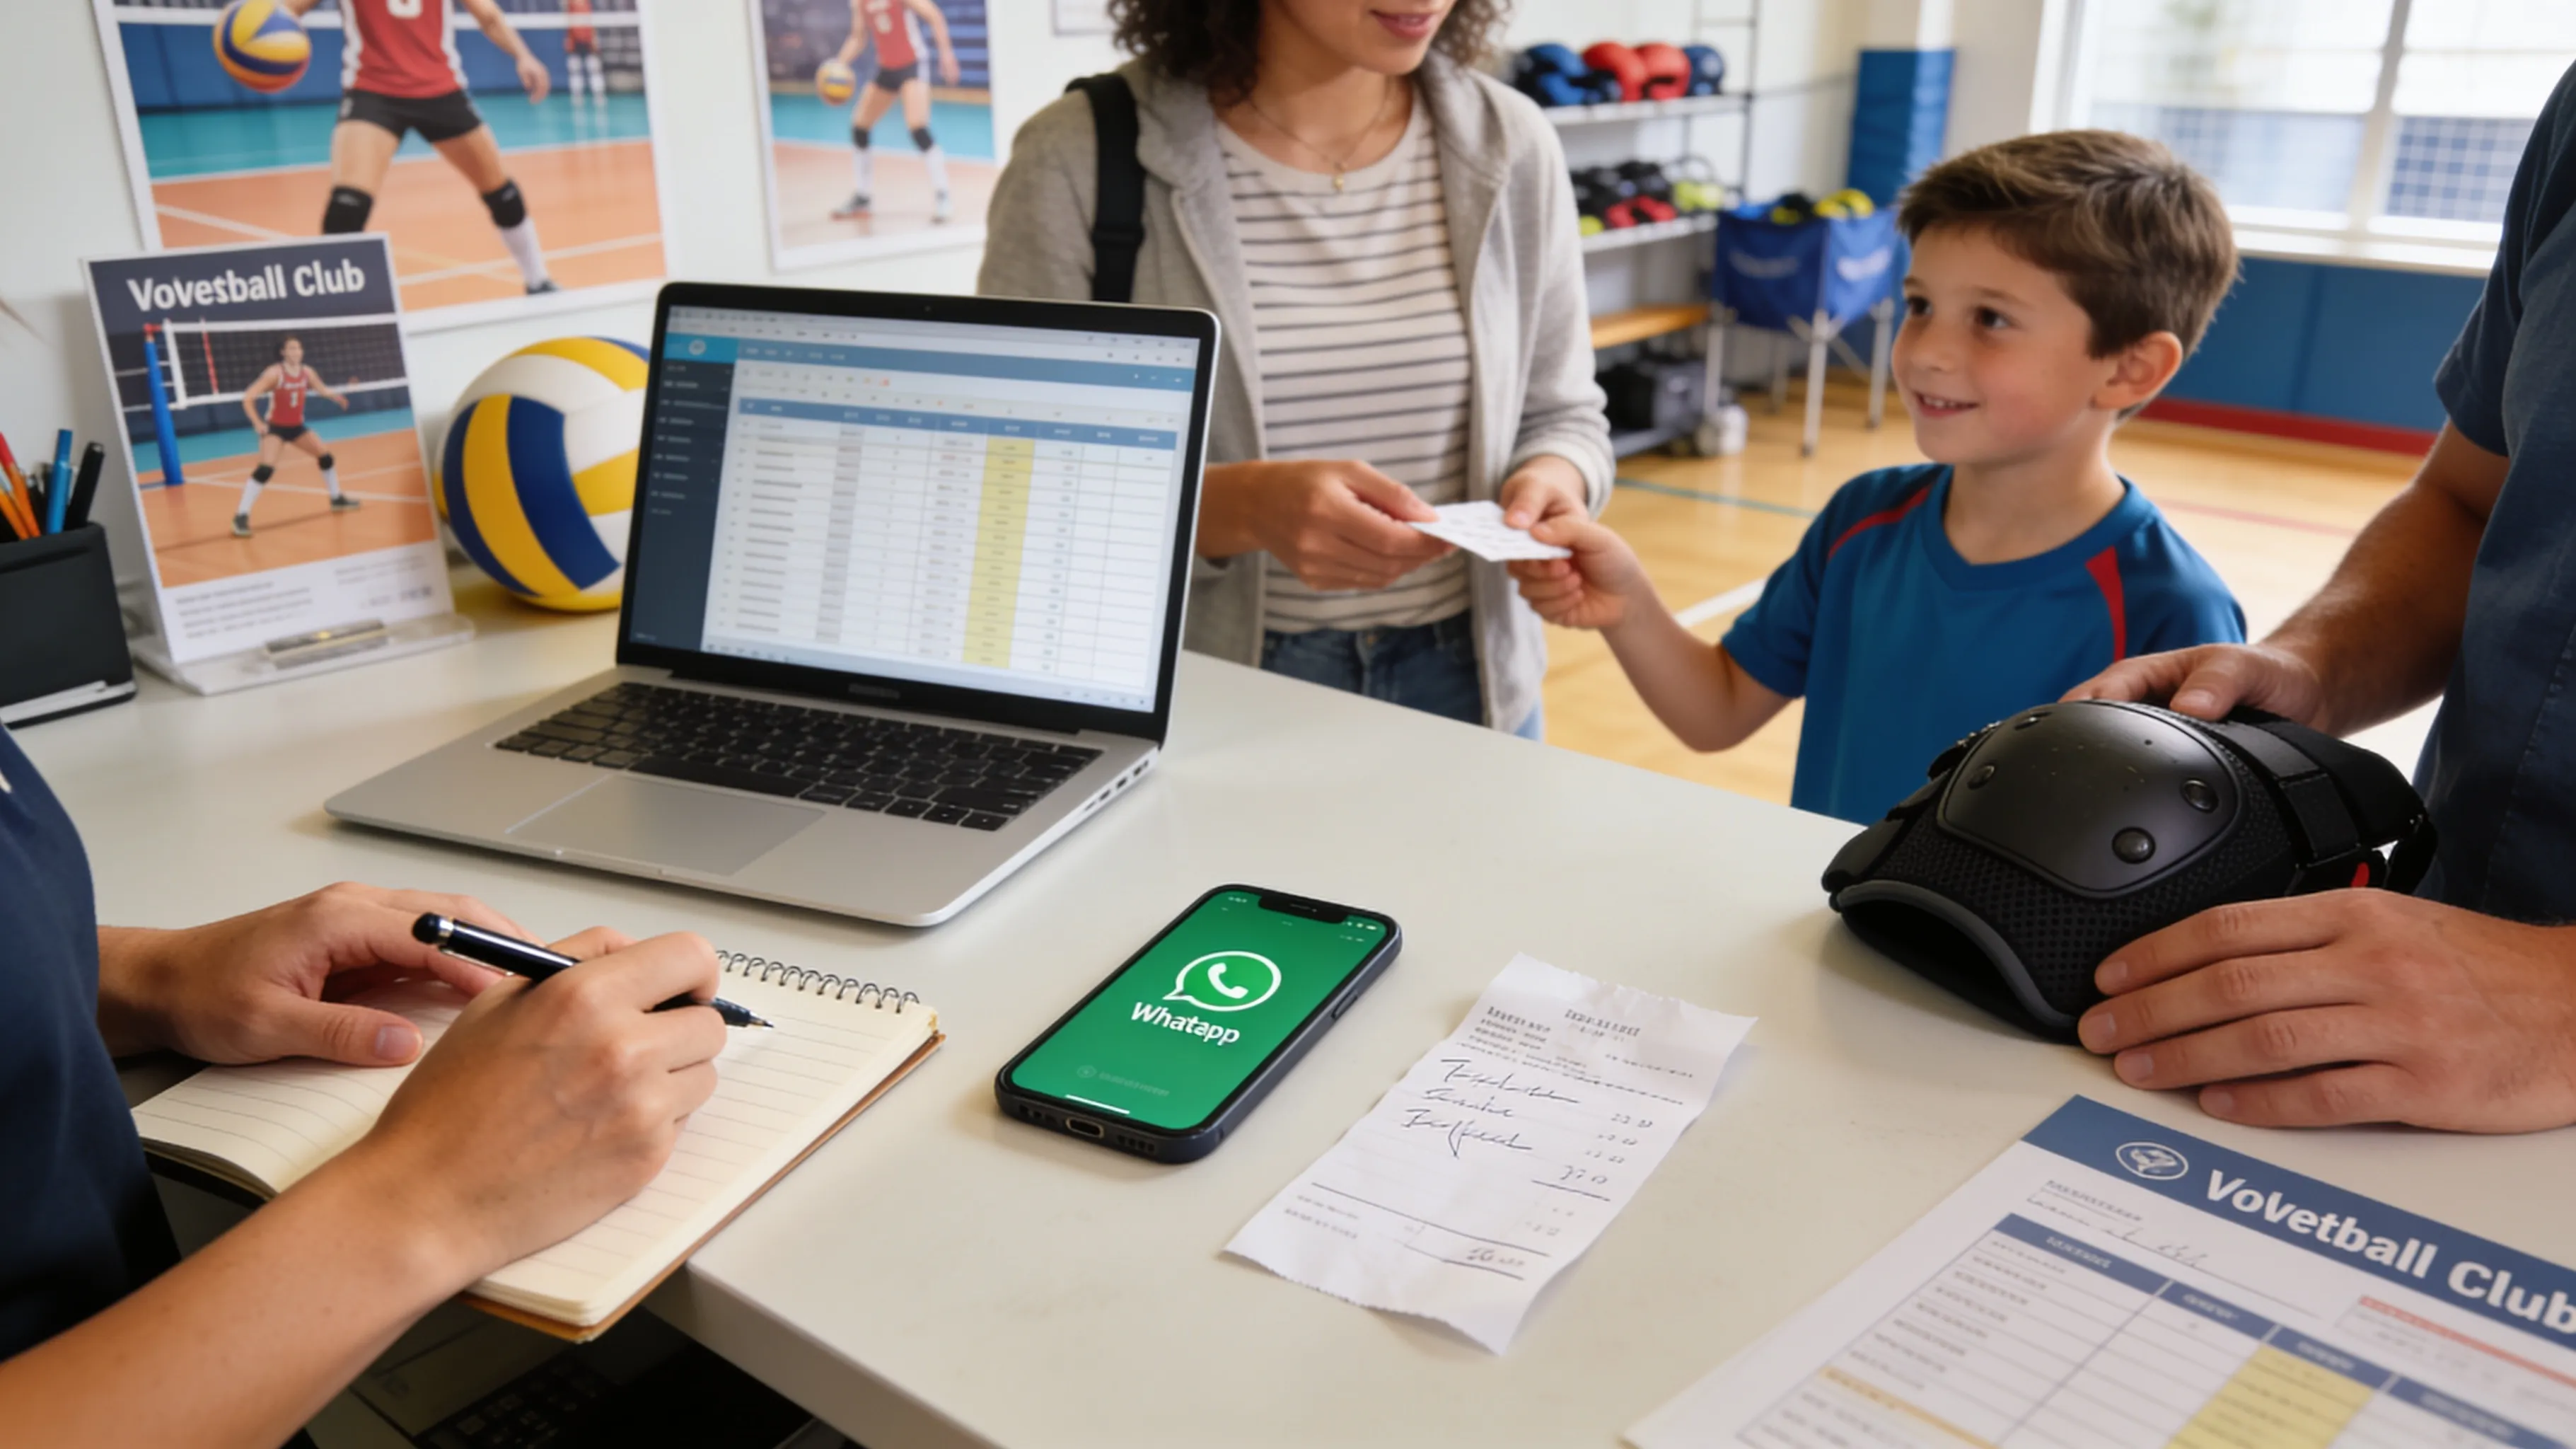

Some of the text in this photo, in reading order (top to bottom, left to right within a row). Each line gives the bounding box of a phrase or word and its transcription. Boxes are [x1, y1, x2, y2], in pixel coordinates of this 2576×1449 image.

[293, 258, 365, 297] Club
[1131, 1001, 1241, 1046] Whatapp
[2447, 1260, 2576, 1335] Club
